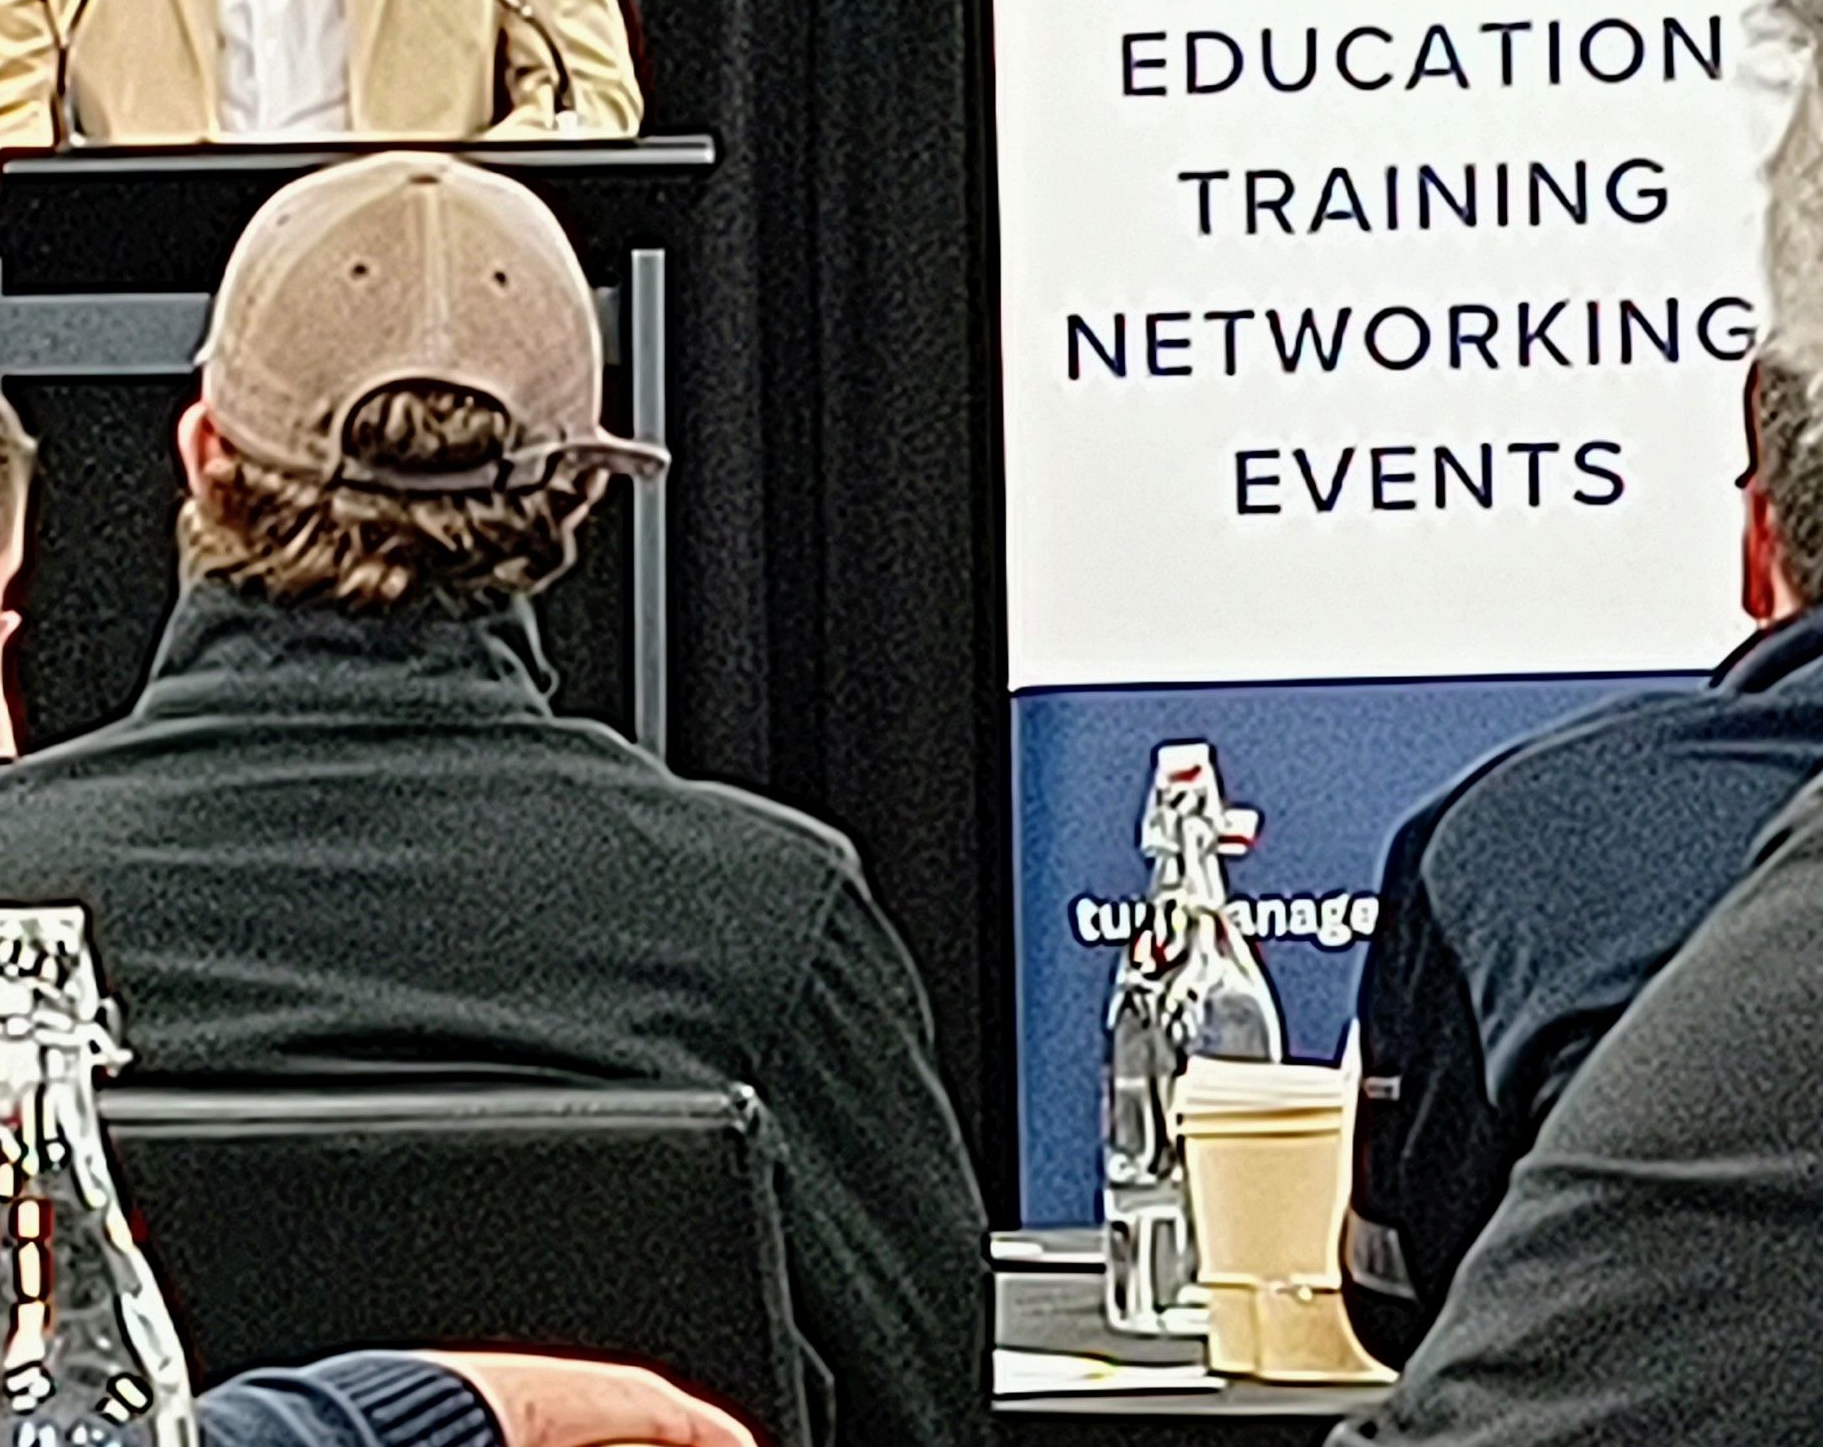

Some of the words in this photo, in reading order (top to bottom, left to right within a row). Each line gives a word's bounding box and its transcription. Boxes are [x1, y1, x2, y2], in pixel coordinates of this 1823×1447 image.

[1121, 15, 1721, 97] EDUCATION
[1177, 158, 1668, 235] TRAINING
[1067, 296, 1757, 380] NETWORKING
[1235, 440, 1624, 515] EVENTS
